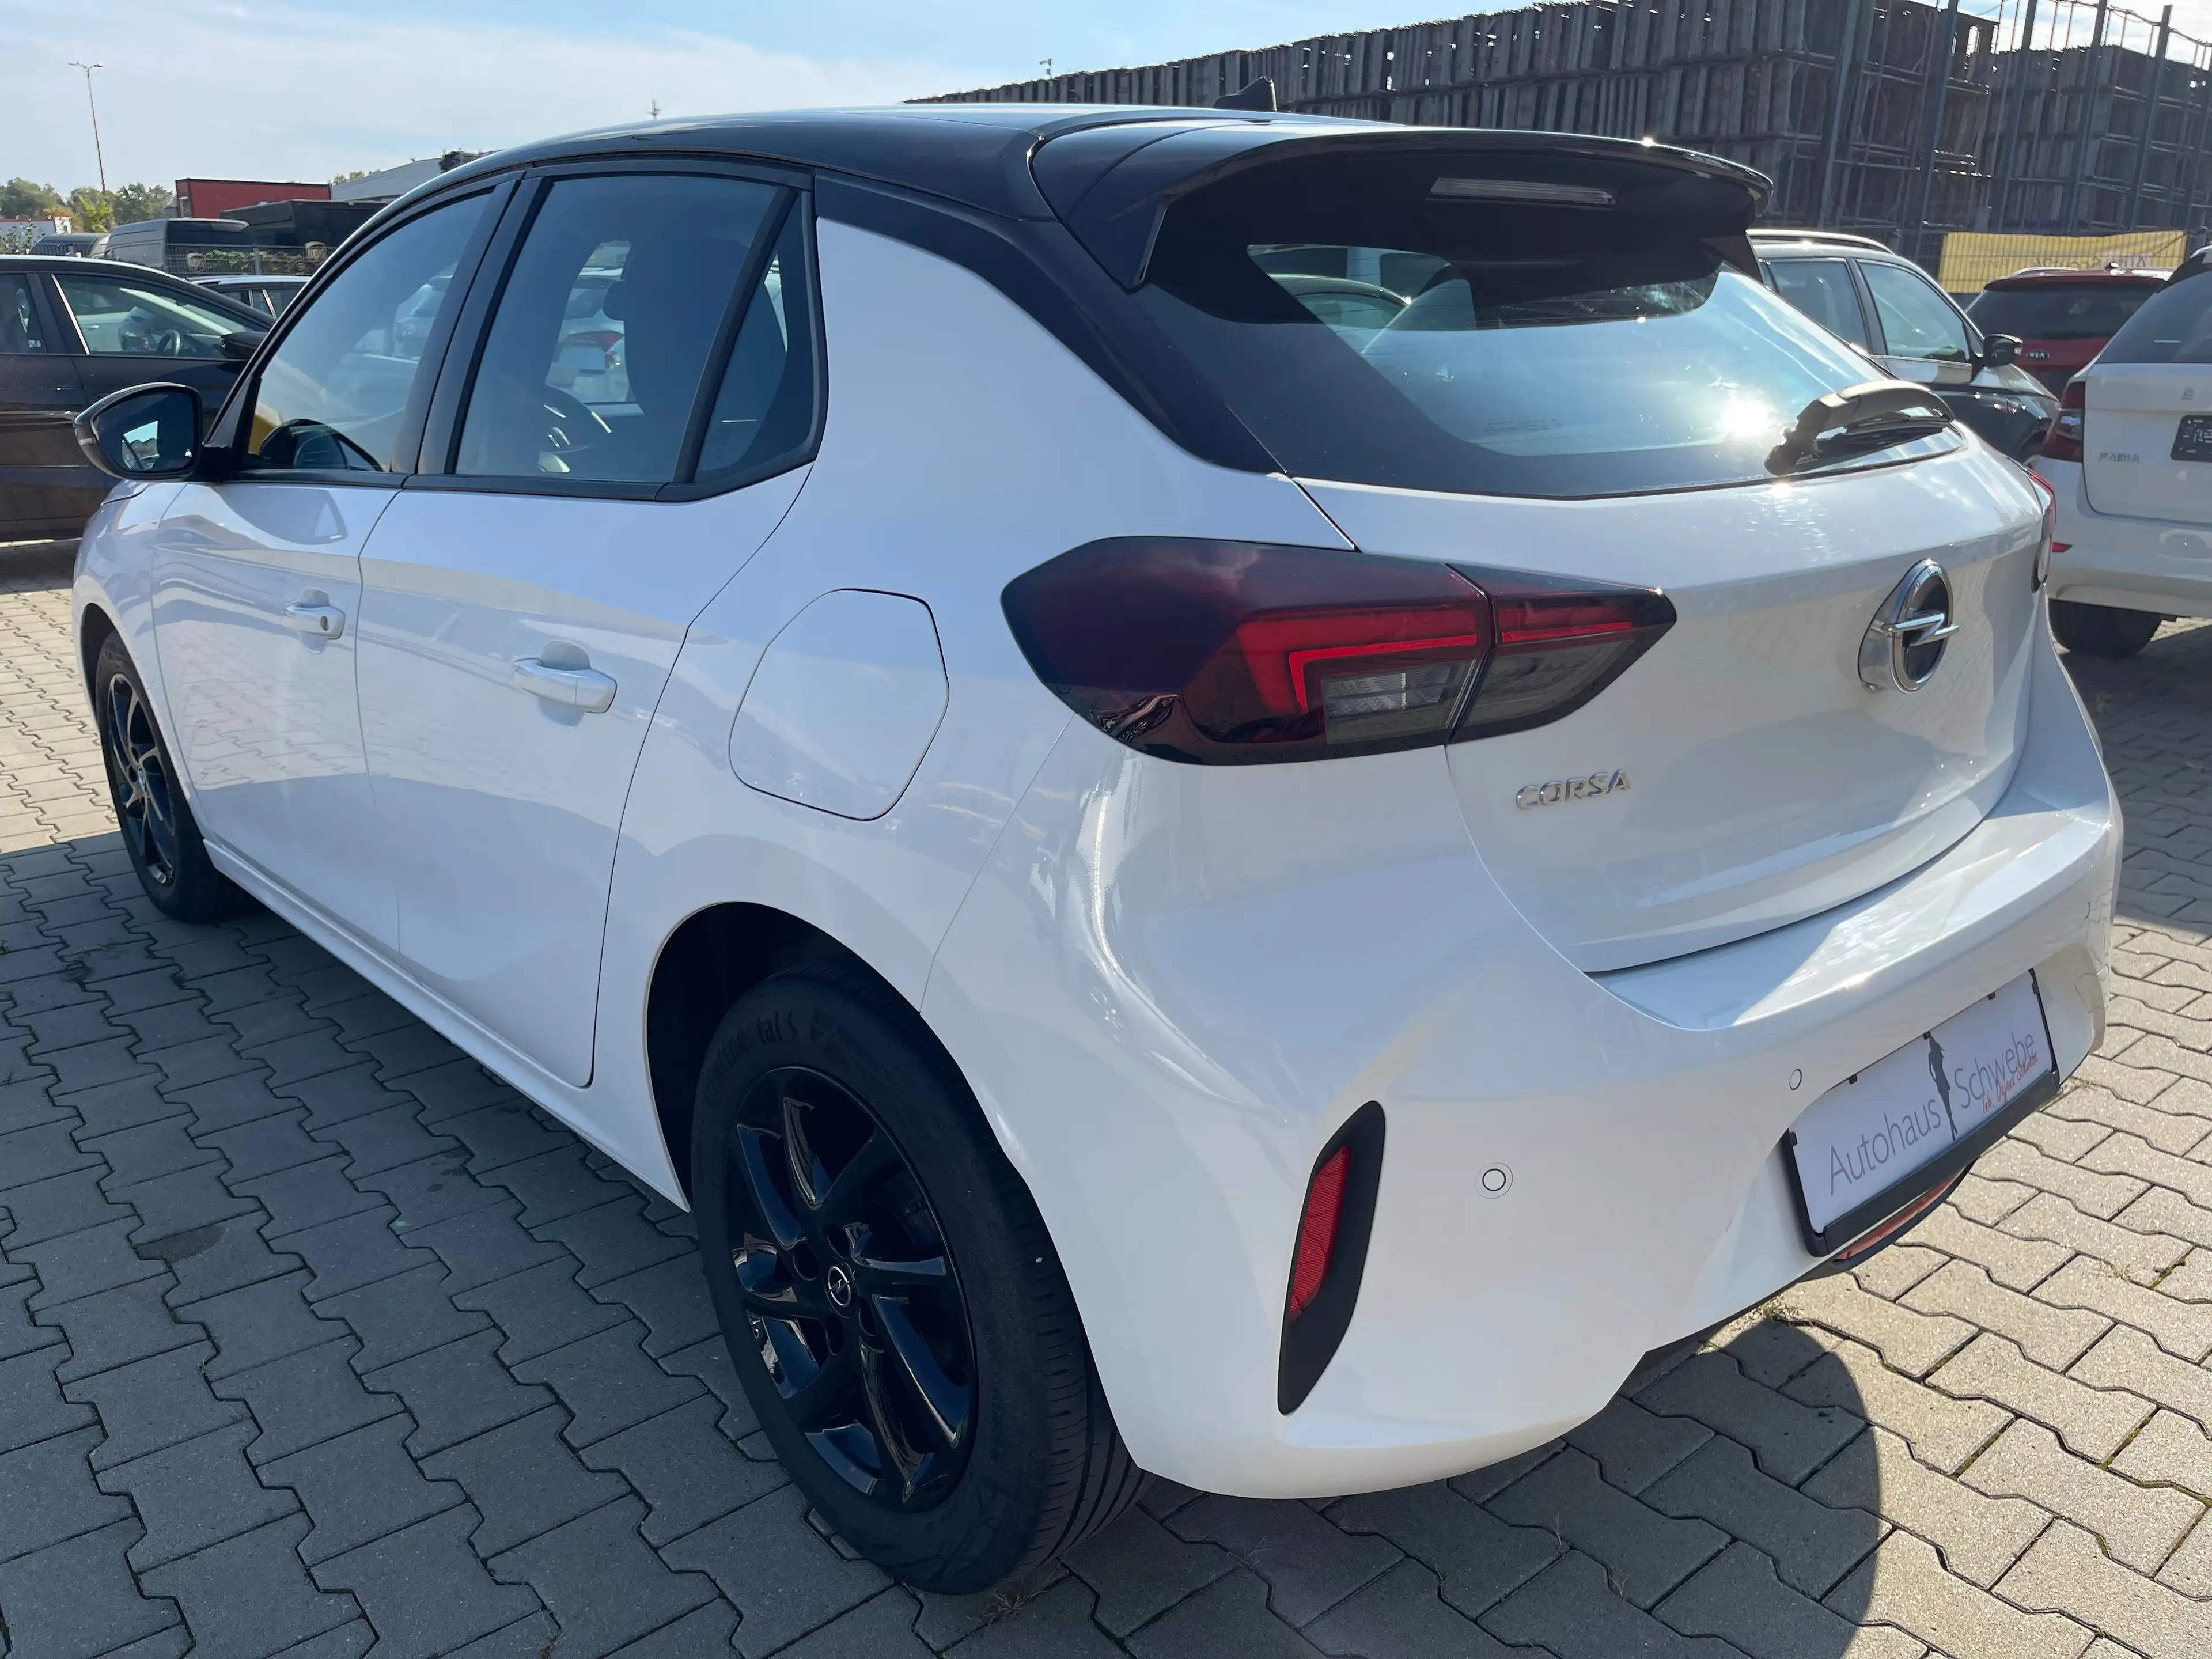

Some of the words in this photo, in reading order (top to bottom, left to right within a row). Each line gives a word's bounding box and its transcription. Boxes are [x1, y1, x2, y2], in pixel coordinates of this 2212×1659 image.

[1516, 769, 1631, 810] CORSA
[1830, 1099, 1941, 1196] Autohaus
[1954, 1032, 2035, 1109] Schwebe
